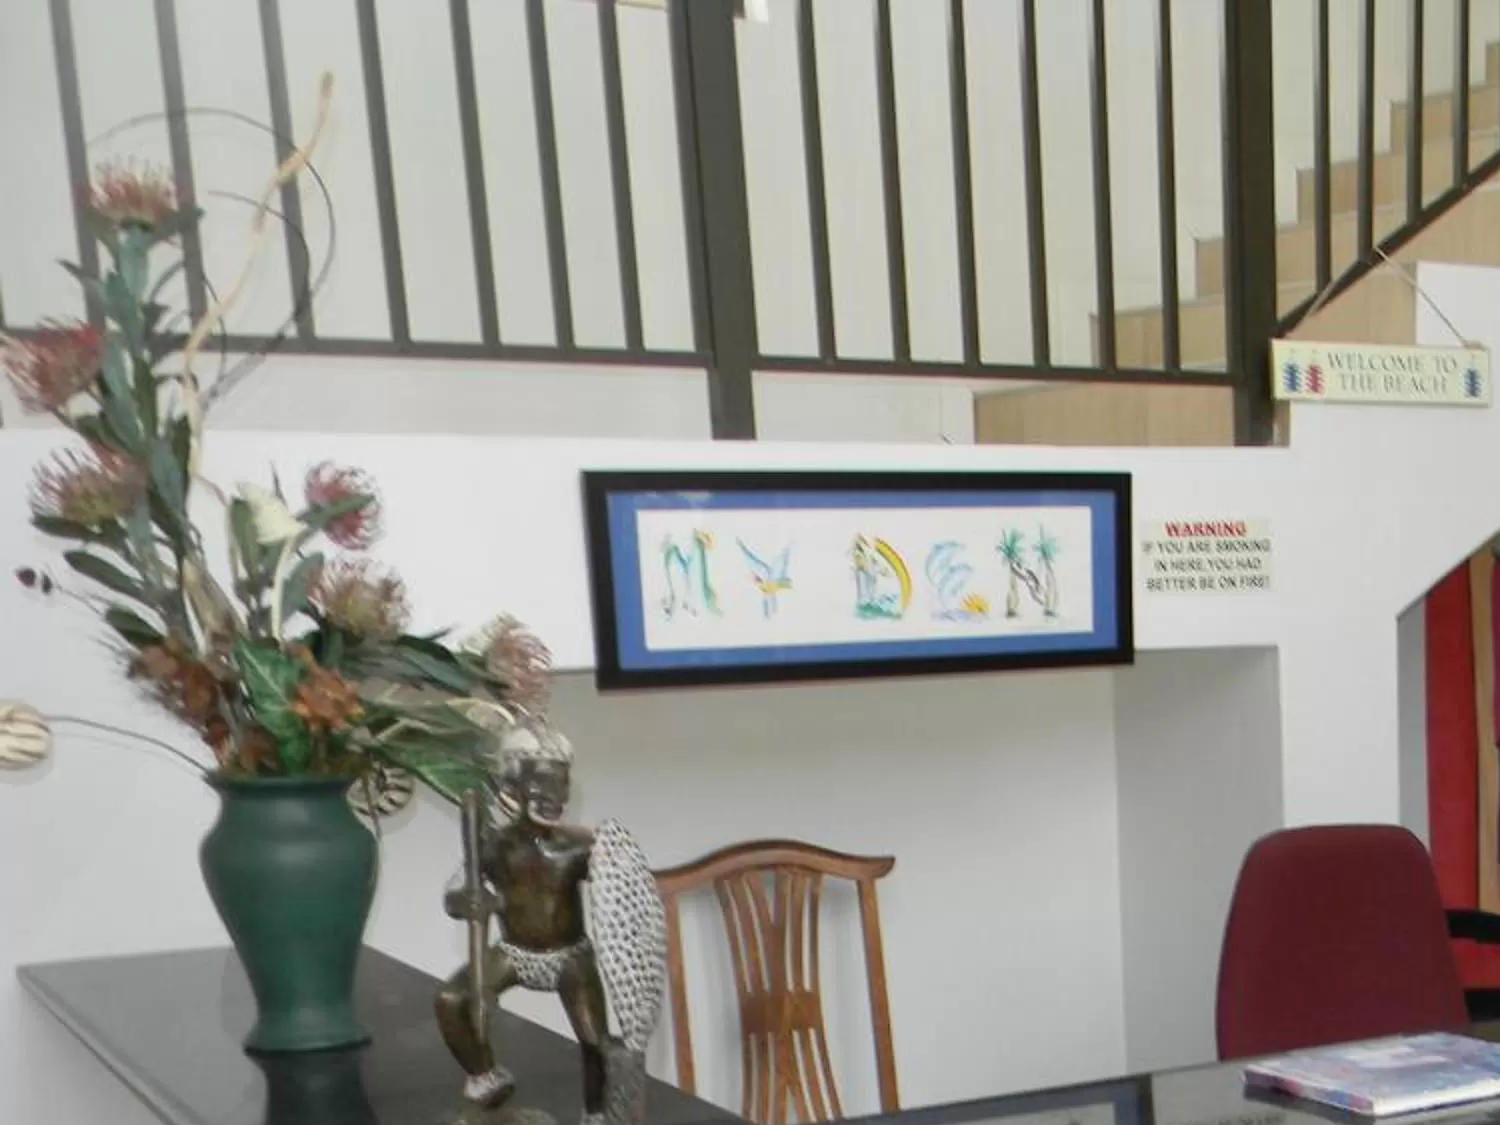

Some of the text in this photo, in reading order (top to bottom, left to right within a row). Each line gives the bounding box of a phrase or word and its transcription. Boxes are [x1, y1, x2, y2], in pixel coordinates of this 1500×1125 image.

[1327, 352, 1457, 373] WELCOME TO
[1340, 373, 1448, 393] THE BEACH
[1164, 521, 1247, 537] WARNING
[1157, 541, 1183, 552] YOU
[1188, 540, 1211, 552] ARE
[1215, 538, 1271, 552] SMOKING
[1154, 560, 1167, 571] IN
[1206, 558, 1234, 570] YOU
[1236, 557, 1261, 569] HAD
[1147, 576, 1197, 590] BETTER
[1199, 576, 1215, 589] BE
[1218, 575, 1237, 588] ON
